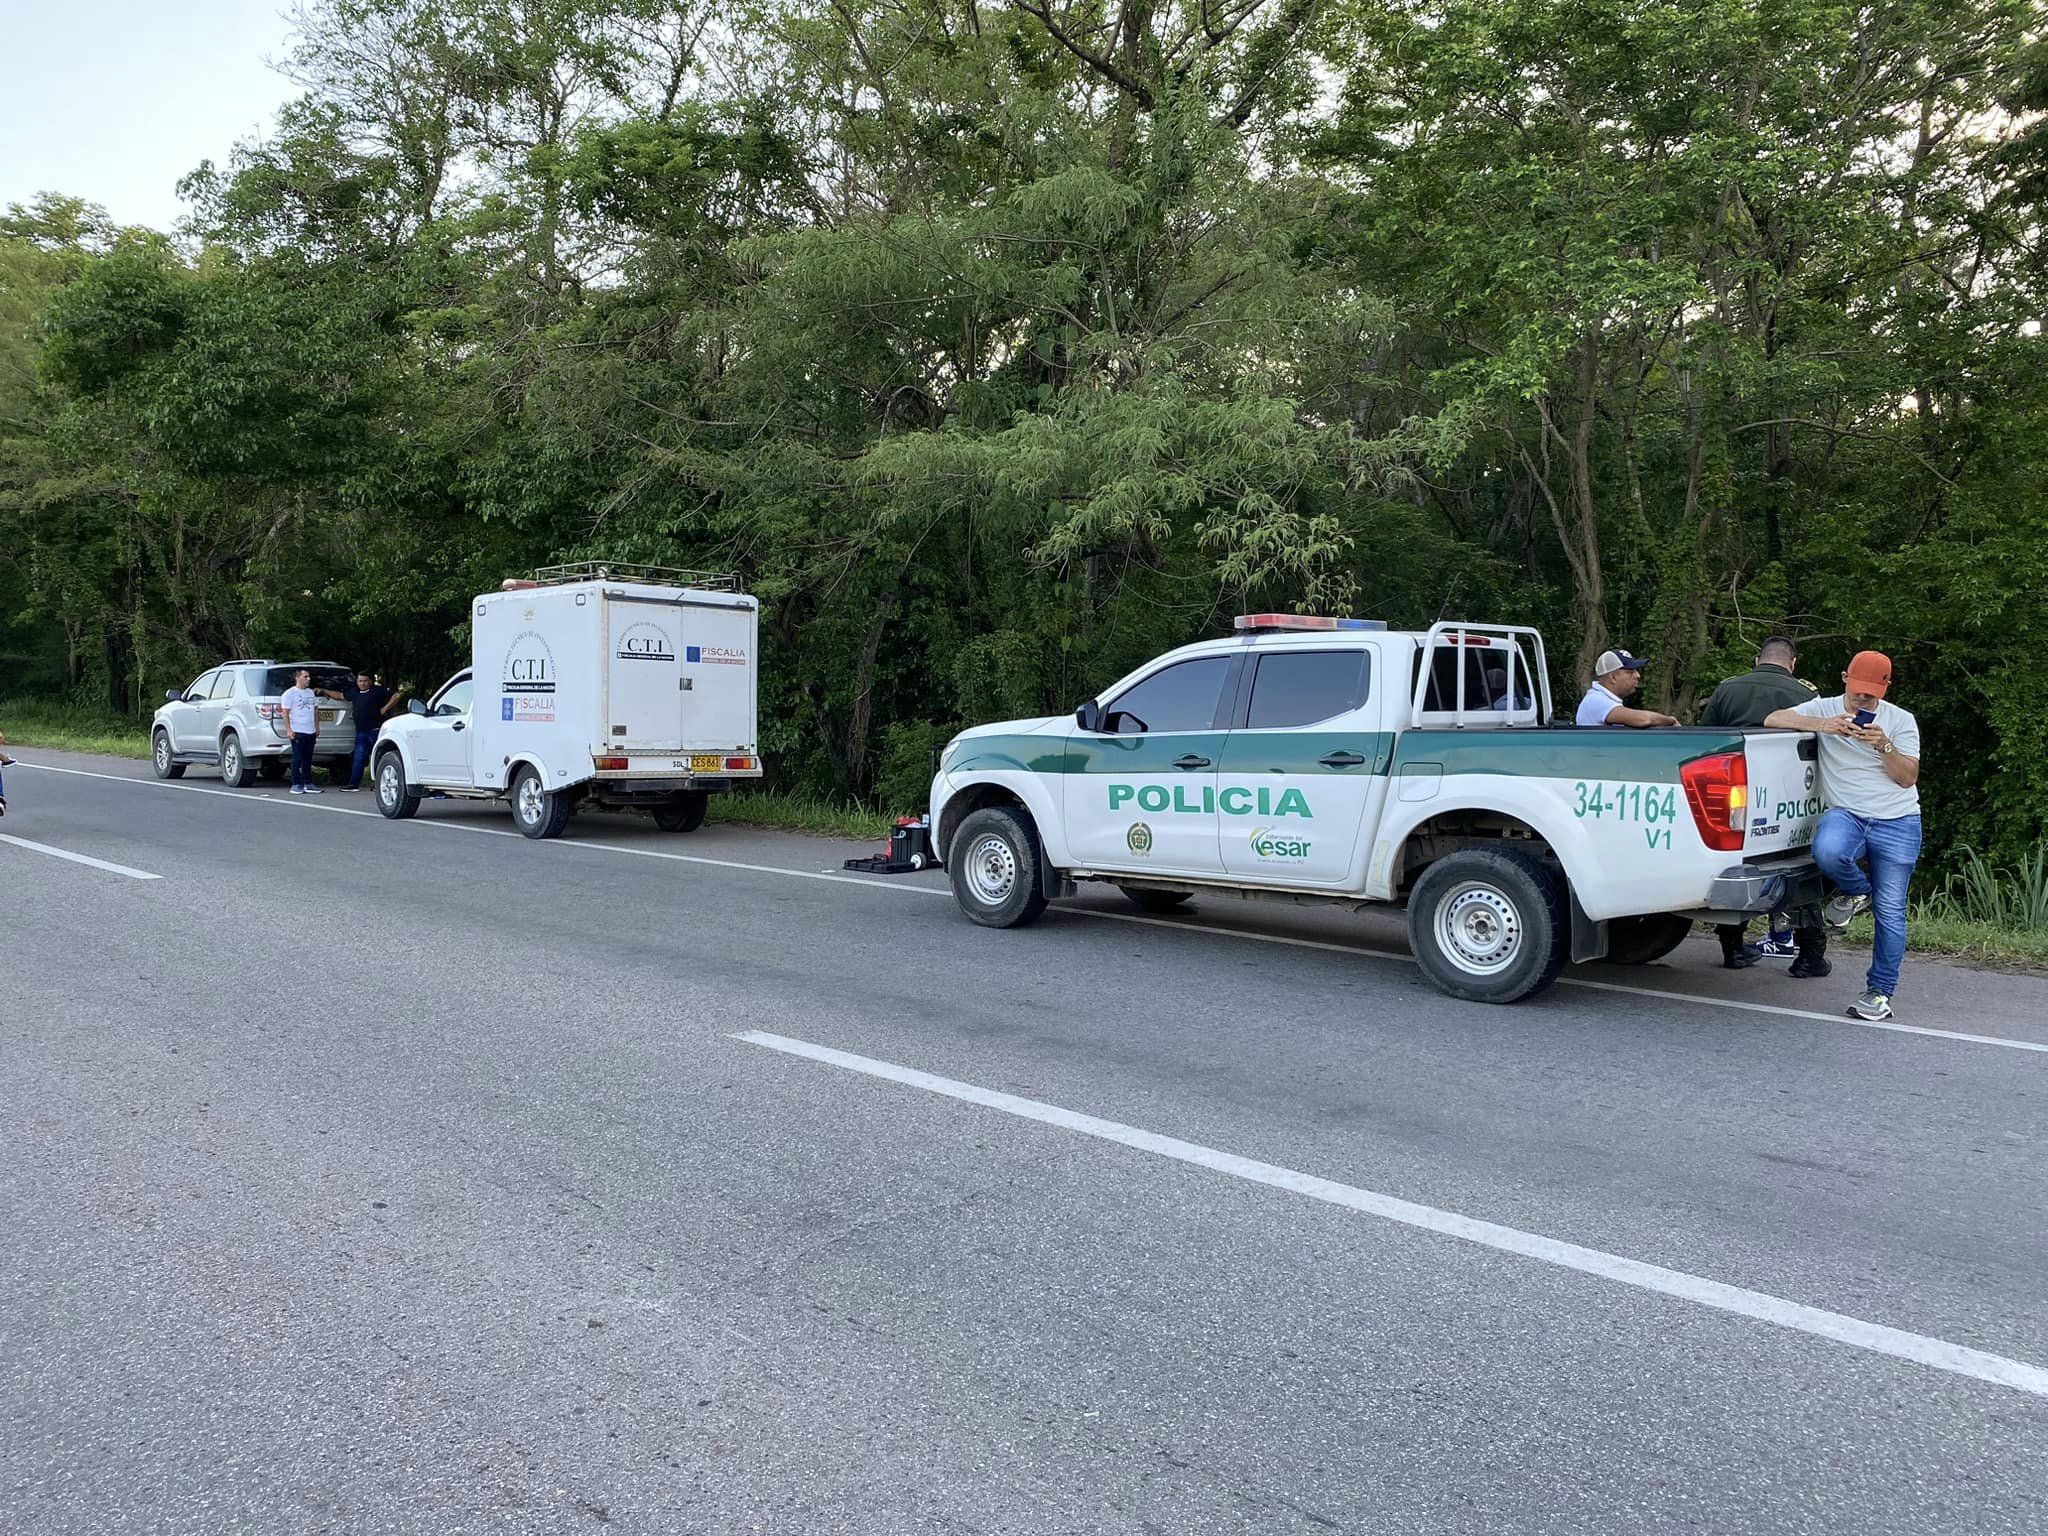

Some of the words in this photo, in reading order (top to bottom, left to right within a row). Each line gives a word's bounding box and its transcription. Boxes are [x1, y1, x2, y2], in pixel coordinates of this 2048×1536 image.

[702, 647, 745, 657] FISCALIA
[512, 659, 545, 680] C.T.I
[515, 698, 555, 710] FISCALIA
[1108, 784, 1314, 818] POLICIA
[1573, 782, 1676, 824] 34-1164
[1755, 786, 1767, 809] V1
[1645, 827, 1671, 850] V1
